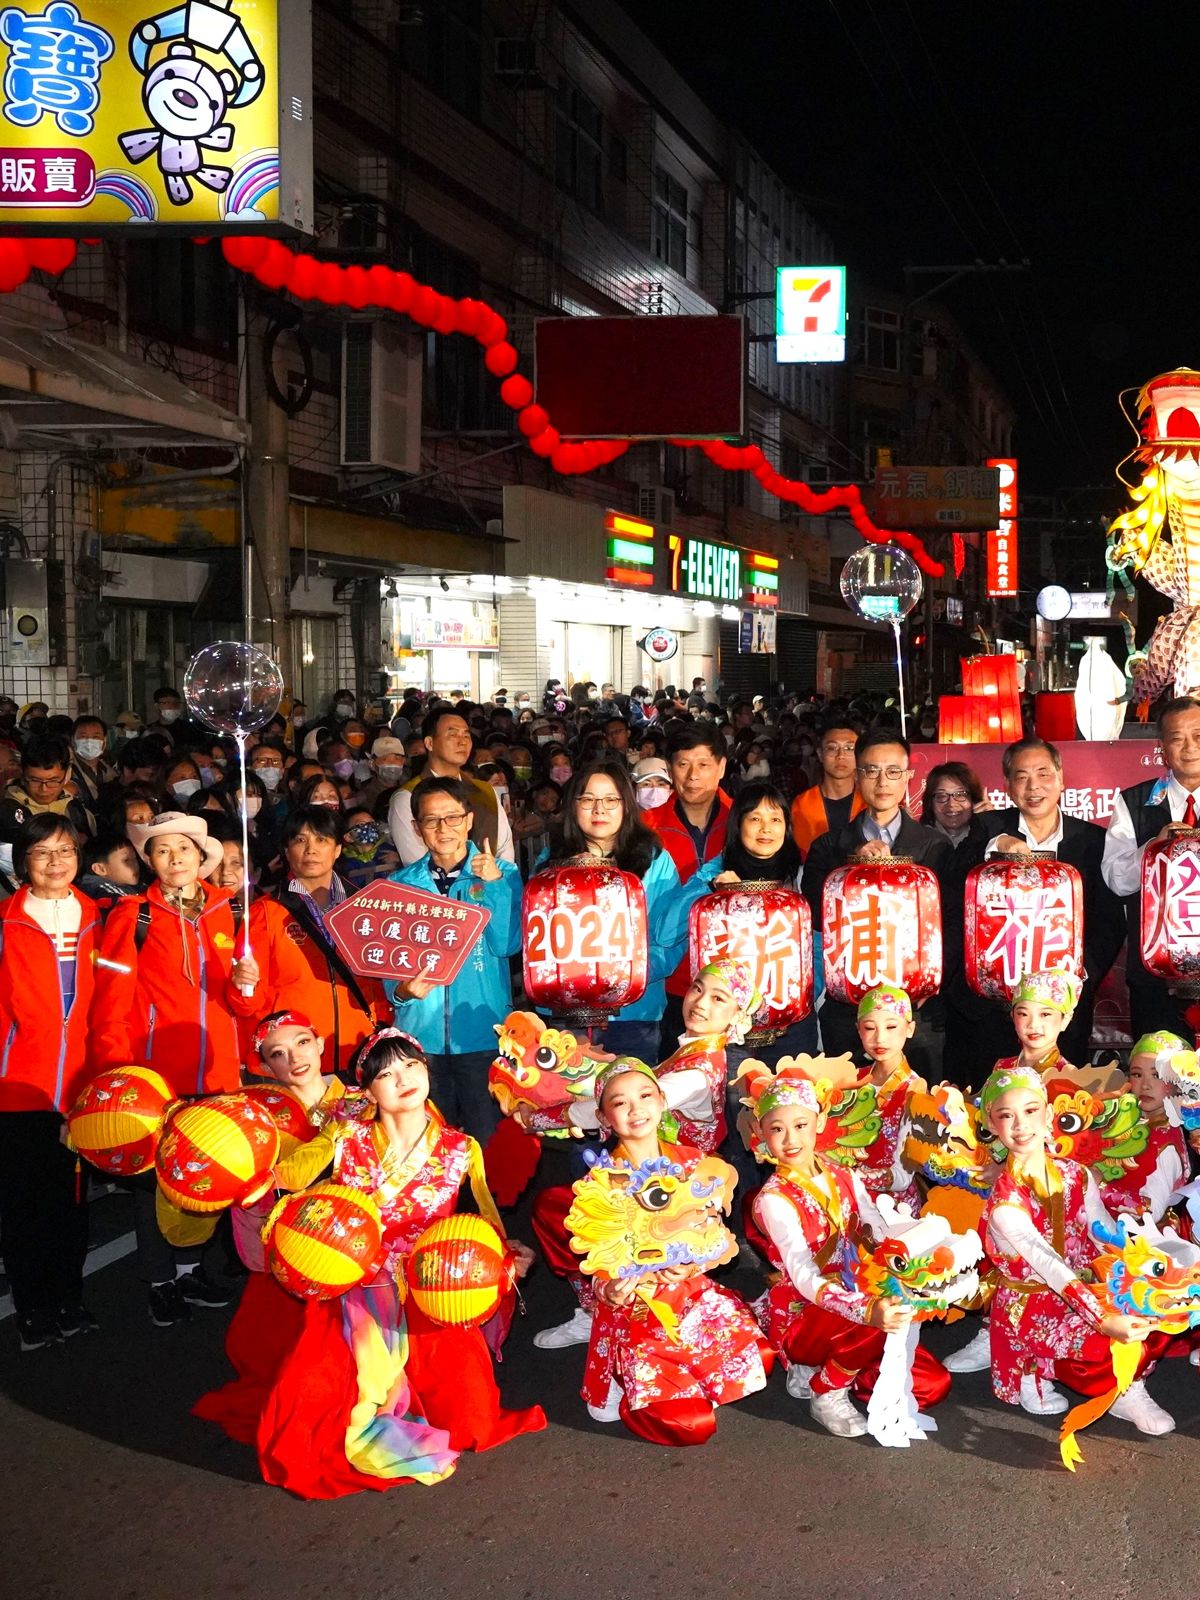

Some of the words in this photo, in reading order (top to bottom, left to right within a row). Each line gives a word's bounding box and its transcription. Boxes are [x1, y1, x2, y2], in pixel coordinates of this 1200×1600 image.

[1, 2, 114, 136] 寶
[2, 157, 77, 193] 販賣
[358, 917, 458, 947] 喜慶龍年
[367, 947, 441, 972] 迎天穿
[528, 907, 634, 967] 2024
[823, 886, 905, 987] 埔
[985, 887, 1079, 986] 花
